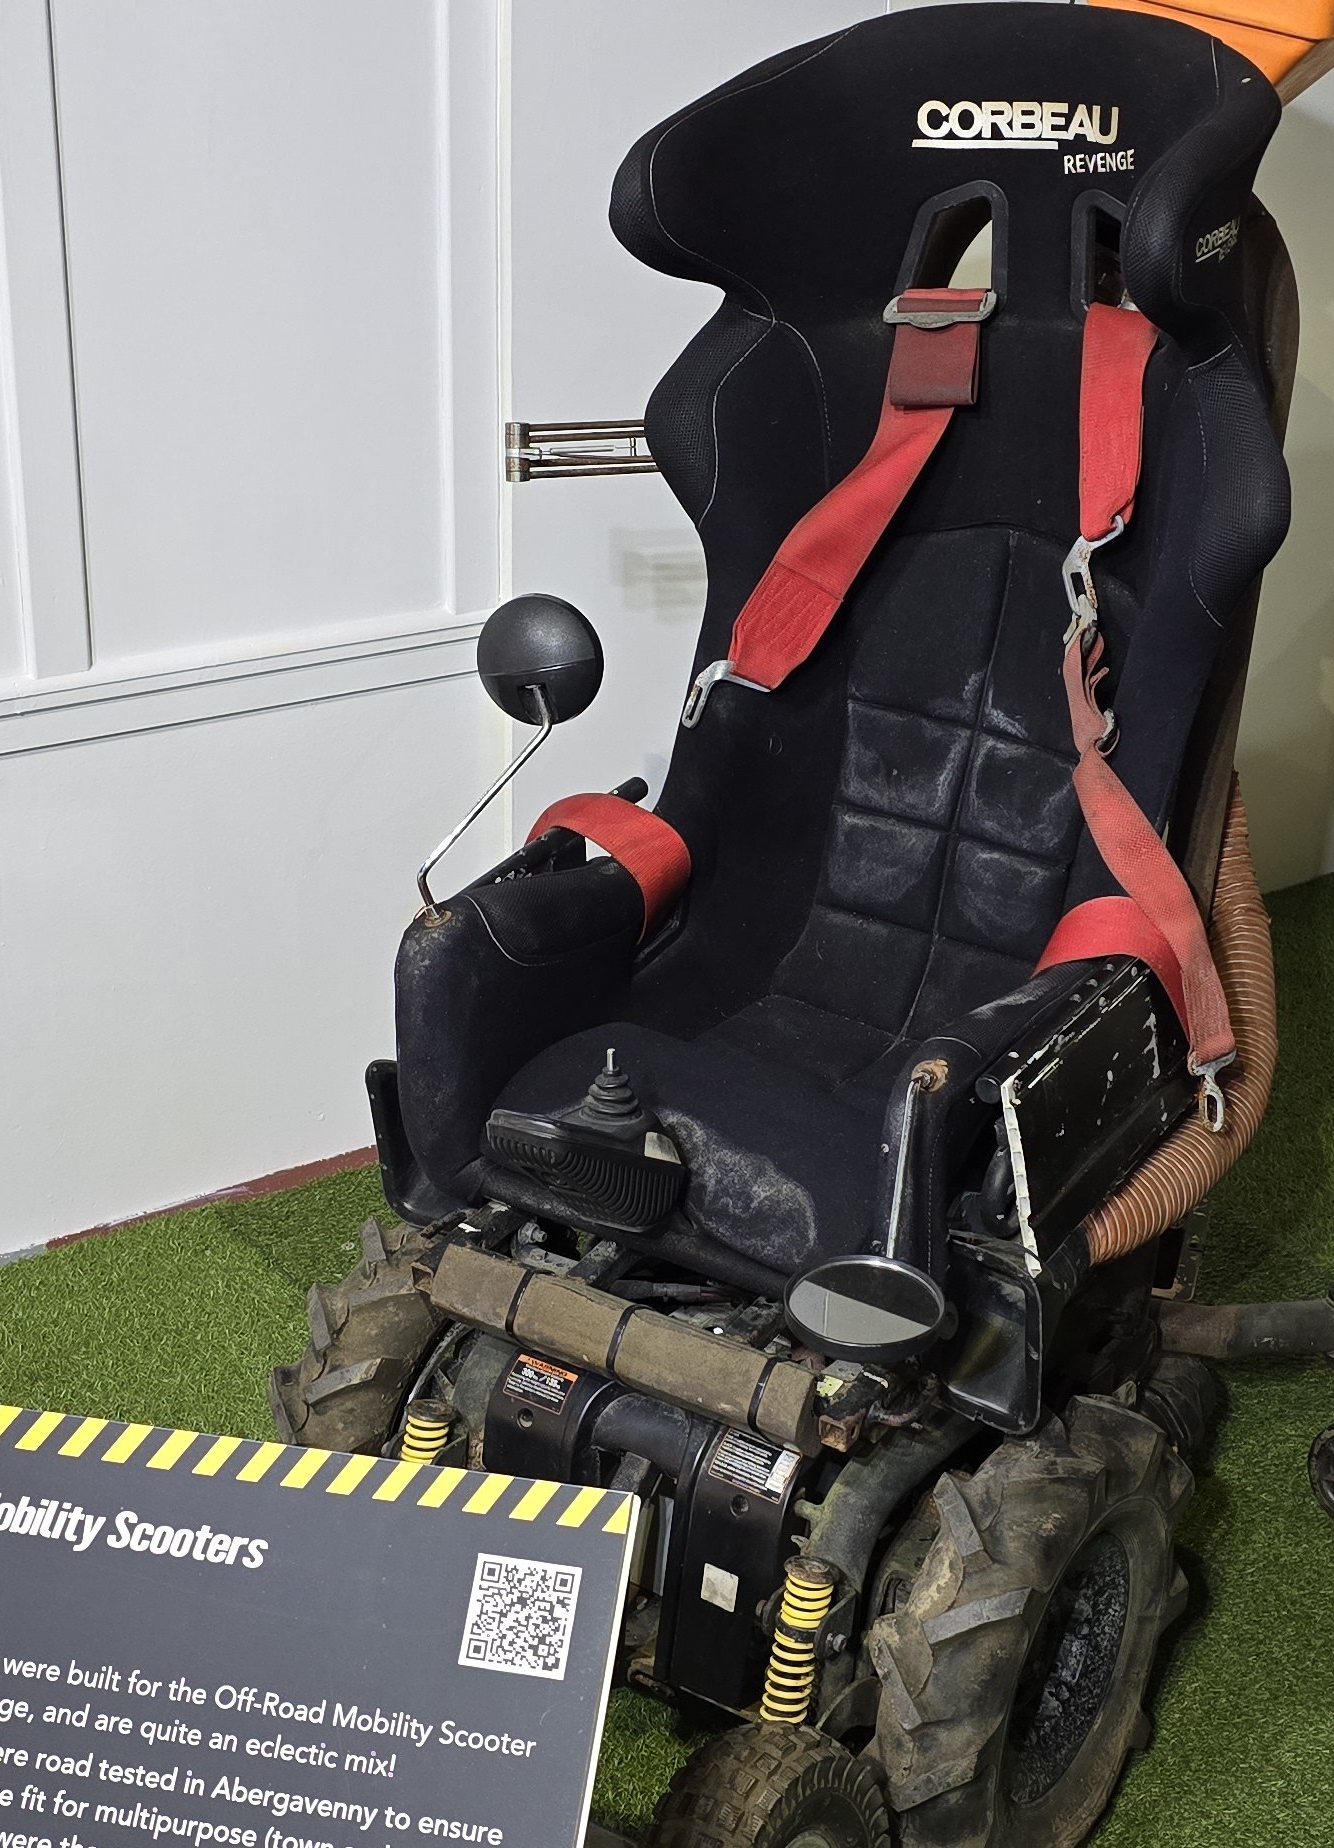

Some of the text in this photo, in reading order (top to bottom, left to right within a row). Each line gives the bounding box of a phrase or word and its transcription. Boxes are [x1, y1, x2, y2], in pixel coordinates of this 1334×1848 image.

[916, 100, 1120, 145] CORBEAU
[1063, 149, 1135, 175] REVENGE
[106, 1511, 269, 1569] Scooters
[3, 1657, 61, 1682] were
[66, 1659, 122, 1692] built
[127, 1669, 163, 1698] for
[168, 1676, 207, 1705] the
[214, 1684, 327, 1725] Off-Road
[332, 1702, 434, 1748] Mobility
[438, 1720, 537, 1758] Scooter
[42, 1703, 91, 1728] and
[94, 1713, 133, 1735] are
[139, 1719, 202, 1746] quite
[208, 1732, 238, 1753] an
[245, 1733, 339, 1769] eclectic
[344, 1750, 397, 1778] mix!
[20, 1784, 47, 1813] fit
[52, 1789, 90, 1819] for
[94, 1802, 258, 1848] multipurpose
[35, 1752, 94, 1778] road
[98, 1759, 179, 1792] tested
[183, 1769, 205, 1797] in
[210, 1775, 379, 1831] Abergavenny
[384, 1806, 411, 1831] to
[417, 1816, 504, 1846] ensure
